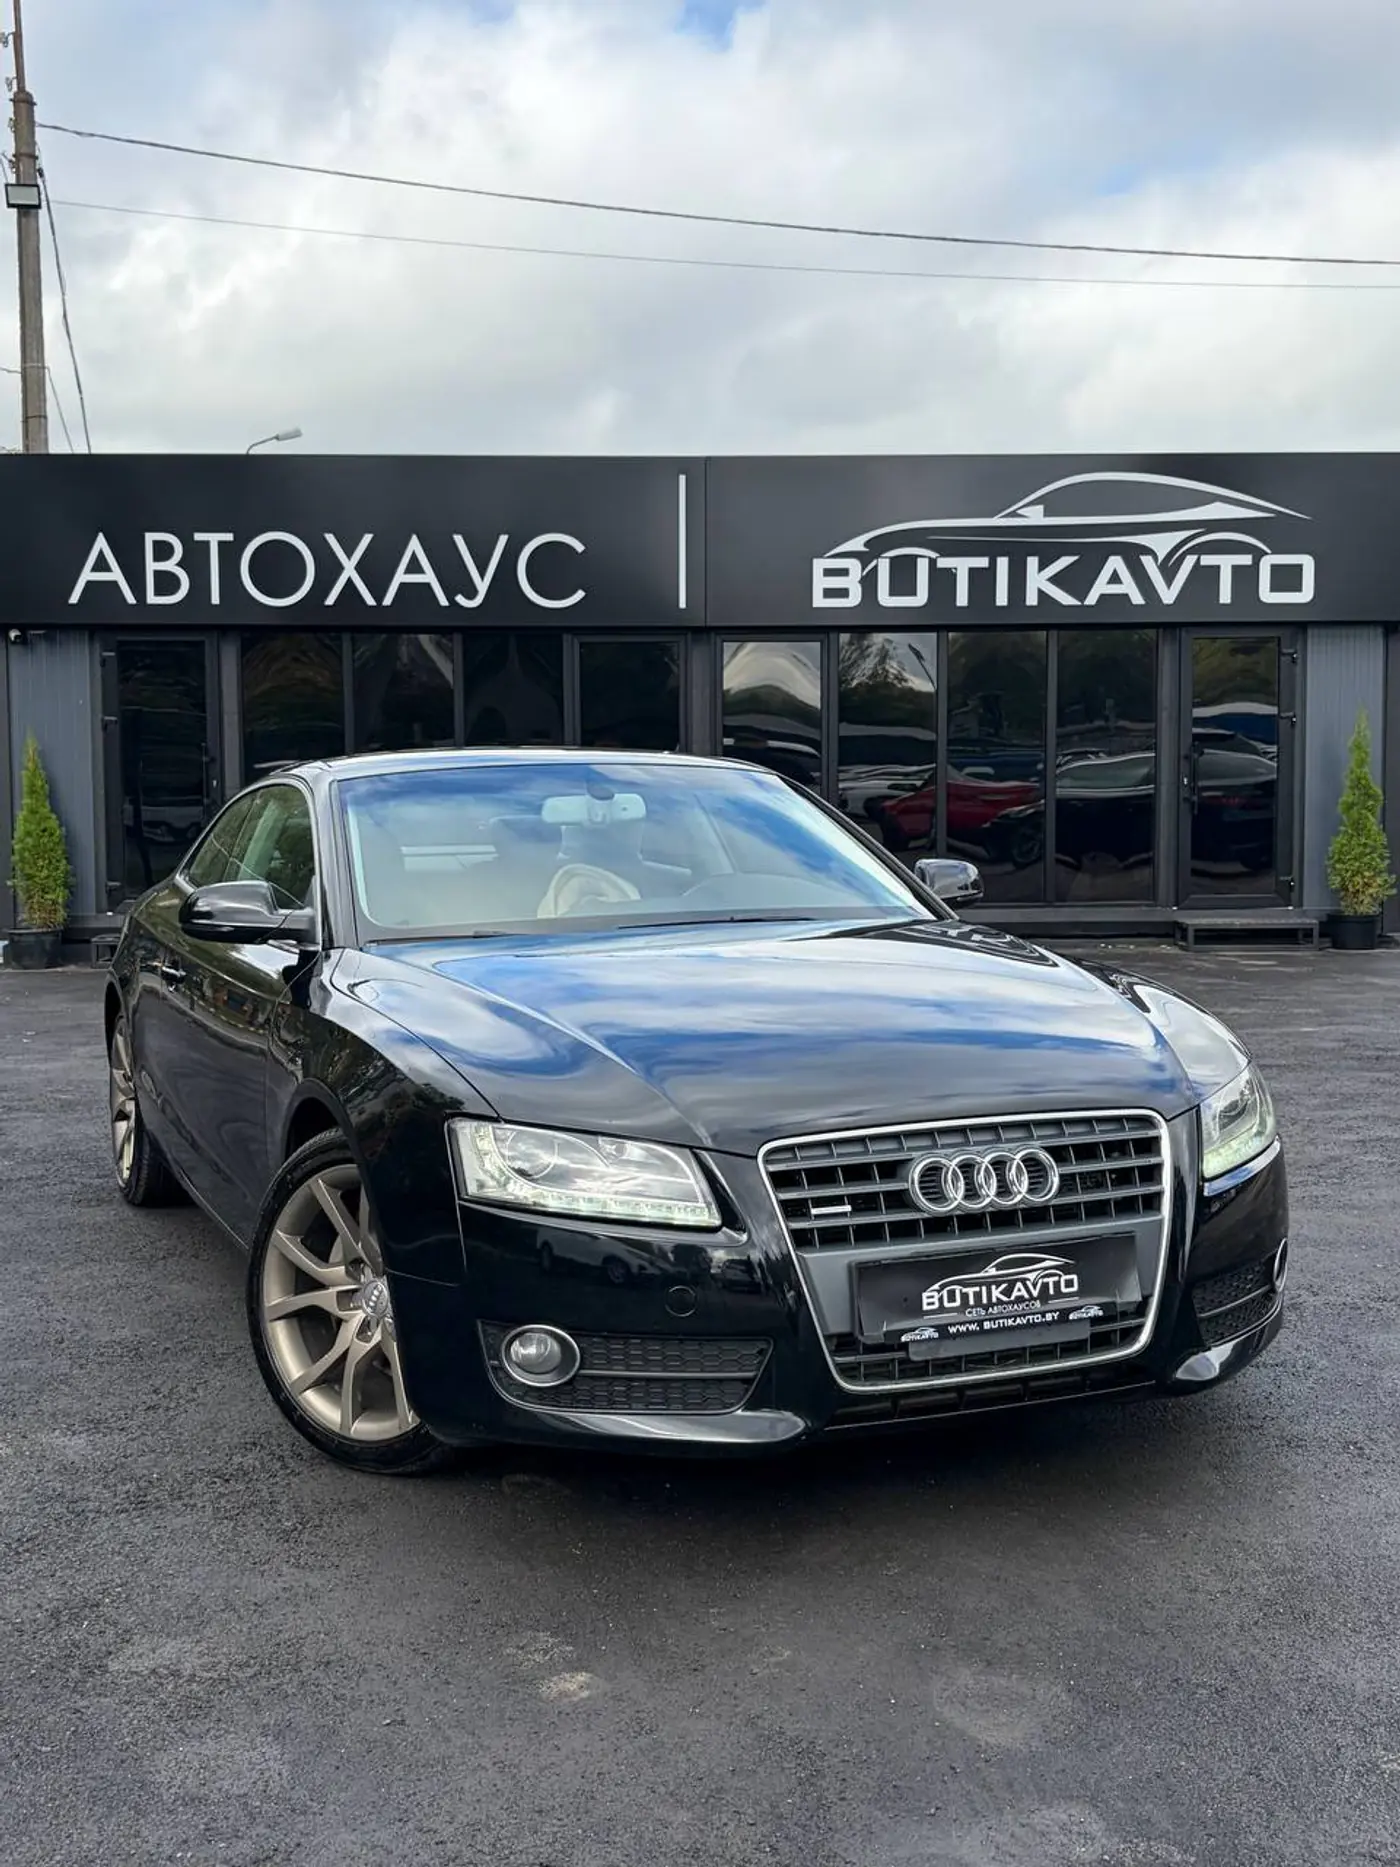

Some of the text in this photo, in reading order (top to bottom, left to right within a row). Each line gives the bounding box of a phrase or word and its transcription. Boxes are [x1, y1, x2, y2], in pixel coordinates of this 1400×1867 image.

[68, 531, 587, 609] АВТОХАУС
[811, 553, 1316, 609] BUTIKAVTO
[922, 1274, 1079, 1311] BUTIKAVTO
[965, 1307, 986, 1317] СЕТЬ
[983, 1311, 1060, 1330] BUTIKAVTO.BY
